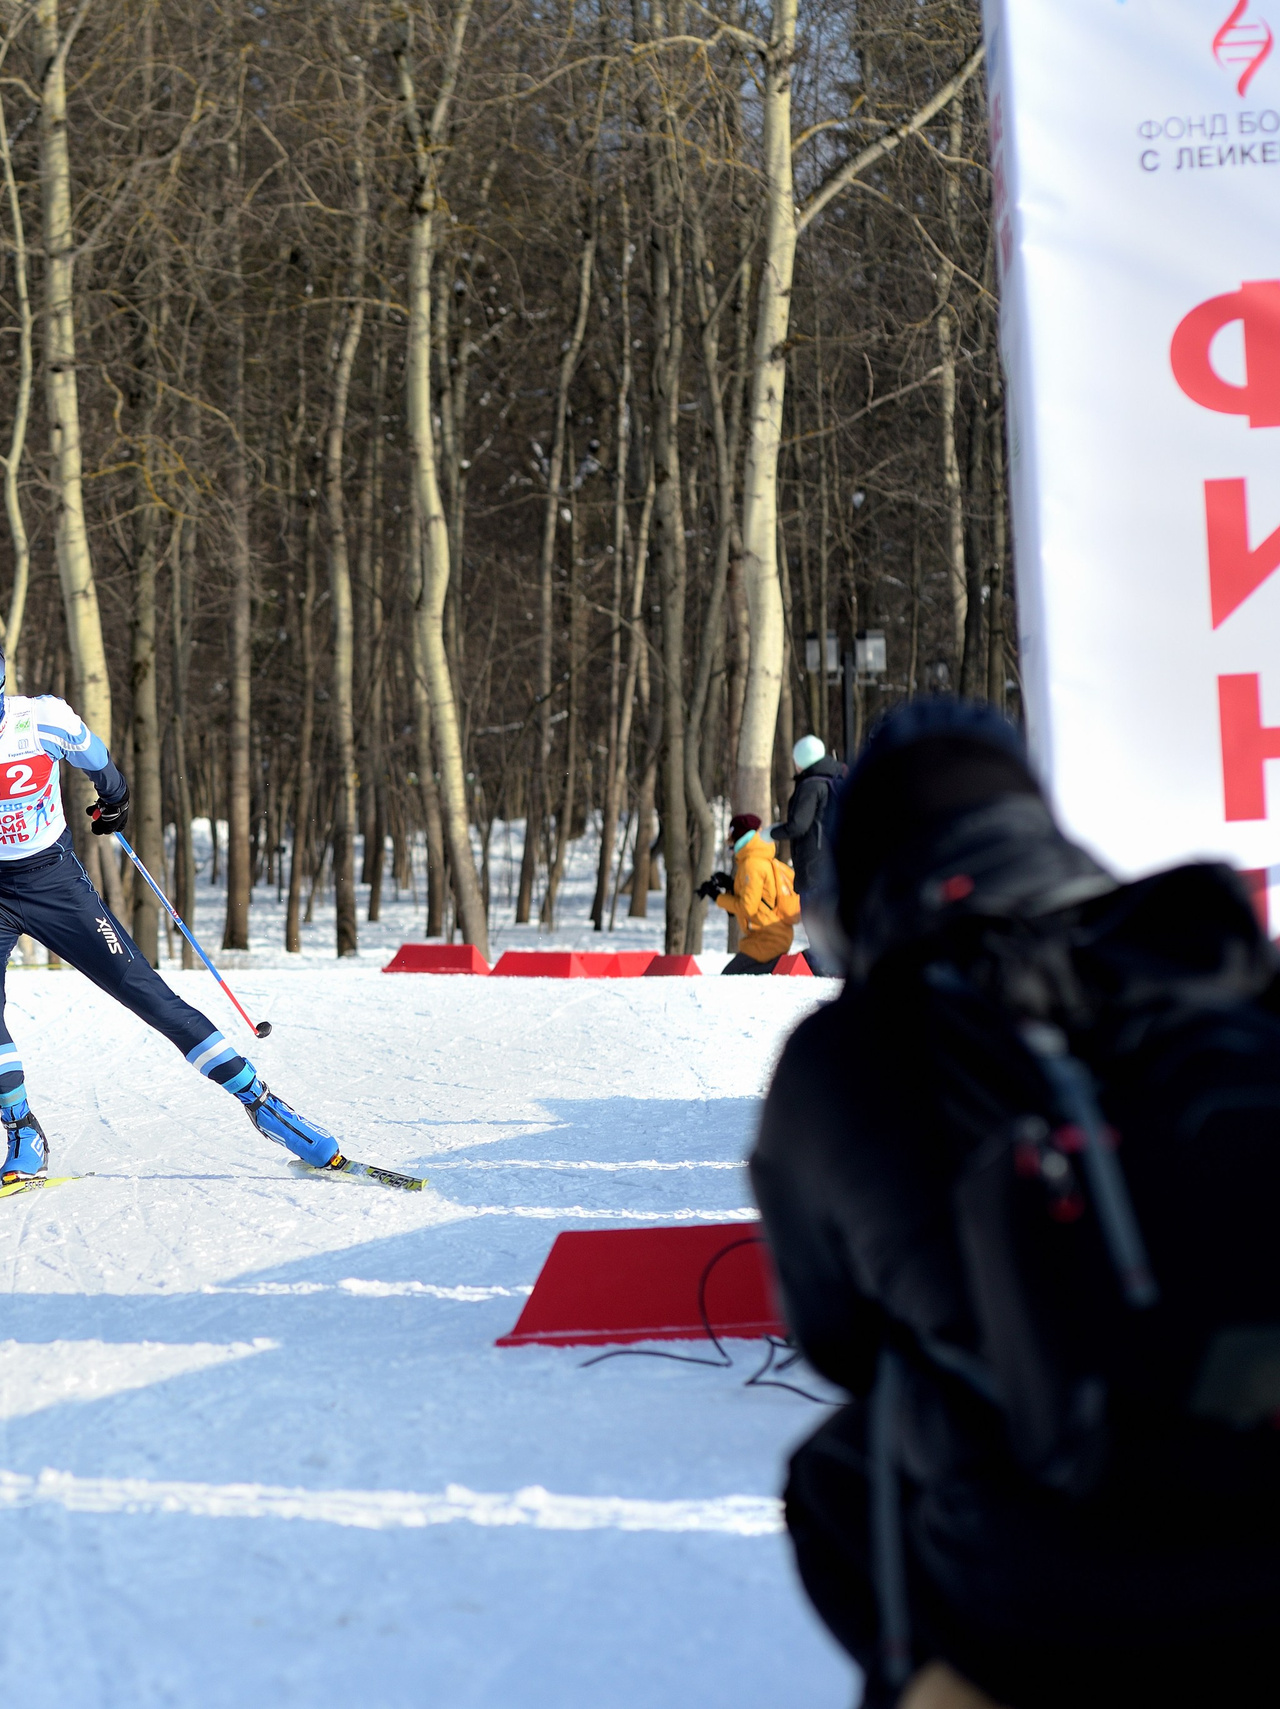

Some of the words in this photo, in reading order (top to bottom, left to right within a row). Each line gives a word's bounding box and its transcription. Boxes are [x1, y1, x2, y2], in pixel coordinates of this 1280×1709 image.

[1137, 114, 1228, 141] ФОНД
[1140, 149, 1160, 172] С
[370, 1169, 411, 1190] FISCHER
